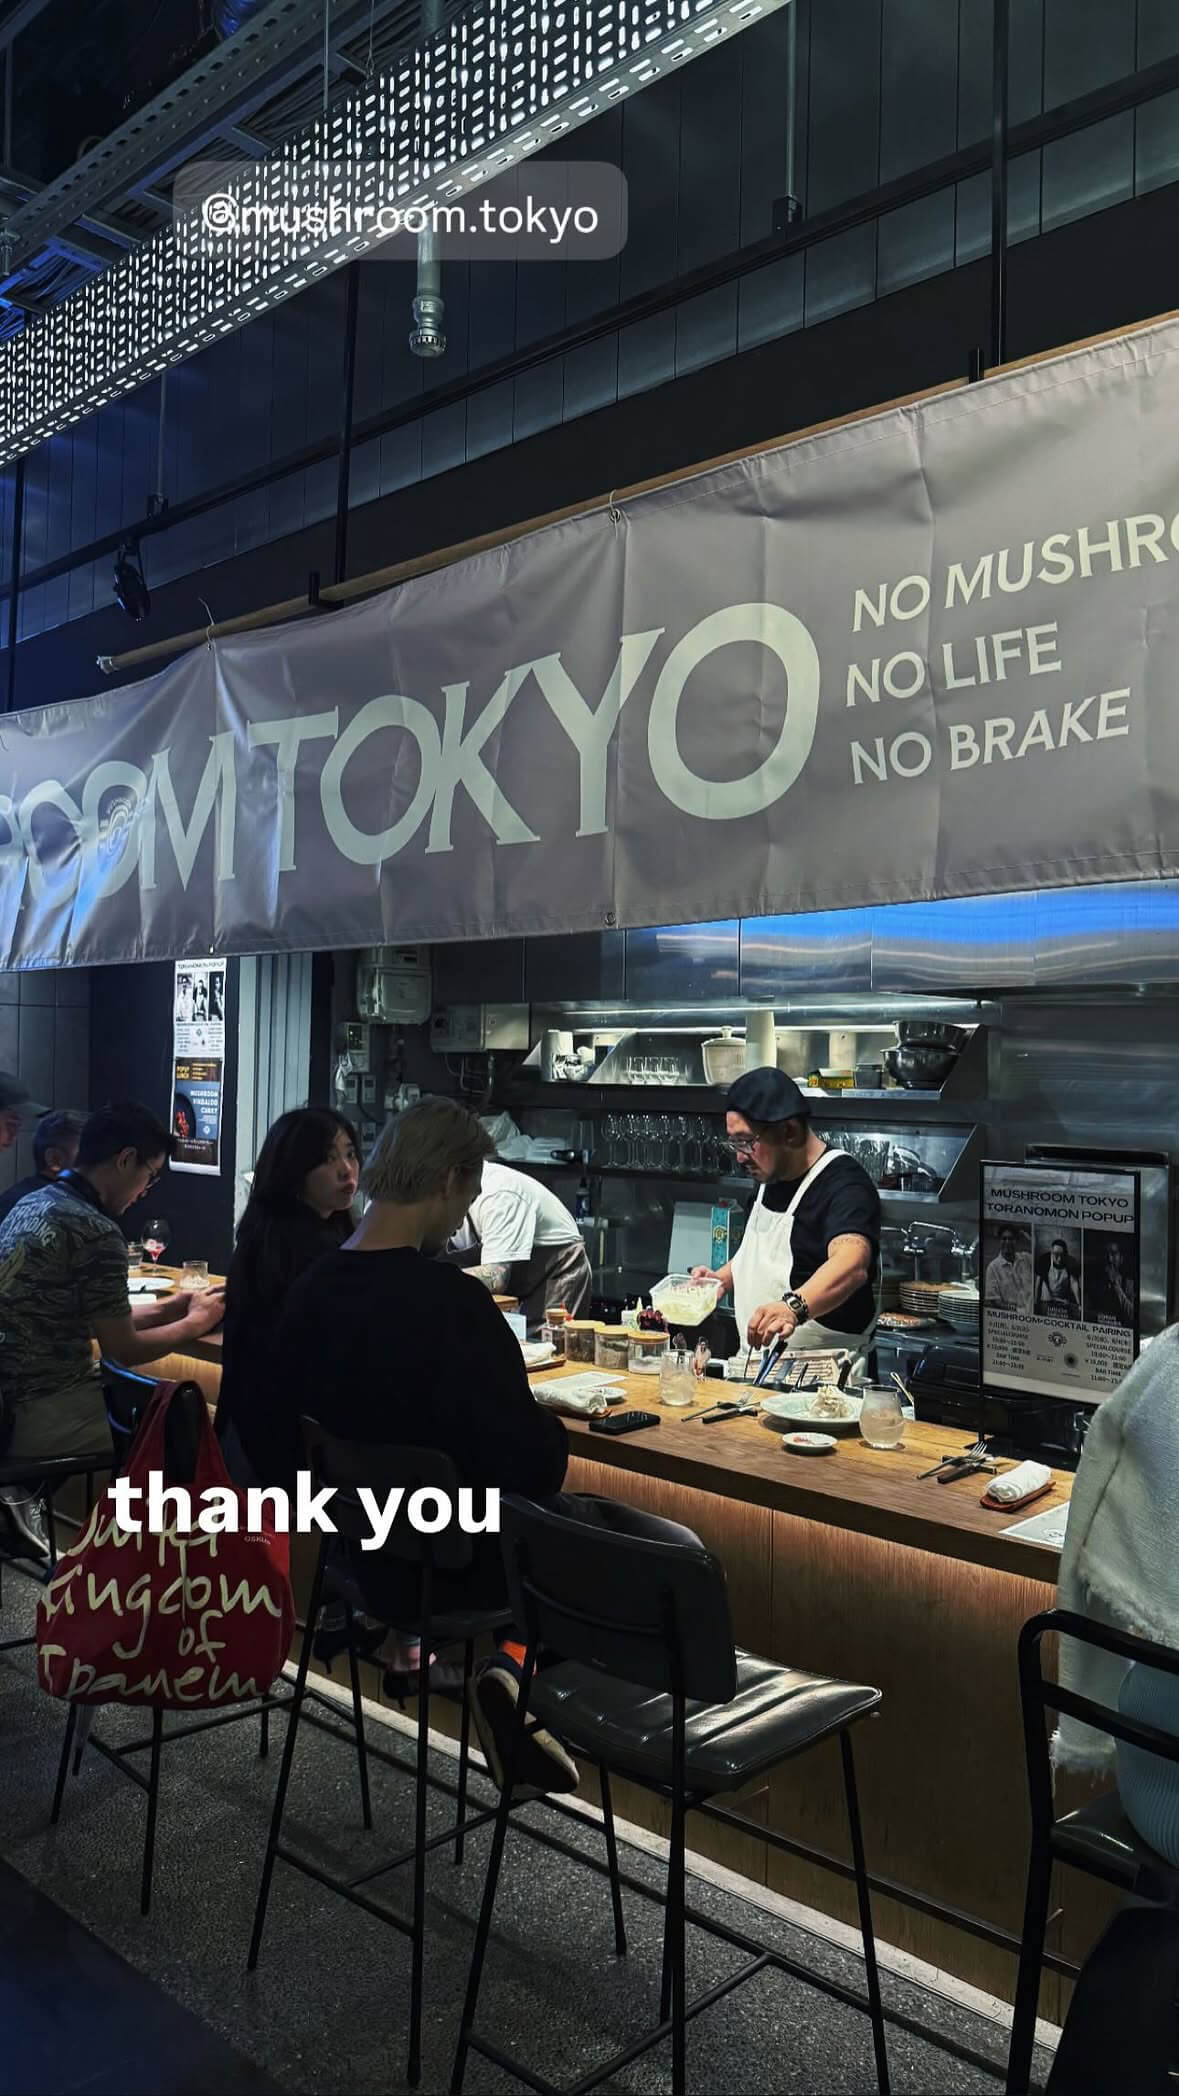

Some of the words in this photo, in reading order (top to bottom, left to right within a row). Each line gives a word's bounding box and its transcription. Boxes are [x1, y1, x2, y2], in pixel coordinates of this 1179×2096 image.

[852, 575, 930, 632] NO
[846, 651, 926, 707] NO
[942, 620, 1062, 690] LIFE
[247, 603, 822, 866] TOKYO
[850, 731, 932, 785] NO
[948, 687, 1131, 771] BRAKE
[986, 1202, 1079, 1219] TORANOMON
[1081, 1211, 1136, 1223] POPUP
[991, 1189, 1075, 1204] MUSHROOM
[1078, 1195, 1129, 1208] TOKYO
[1092, 1326, 1131, 1337] PAIRING
[178, 1609, 226, 1663] of
